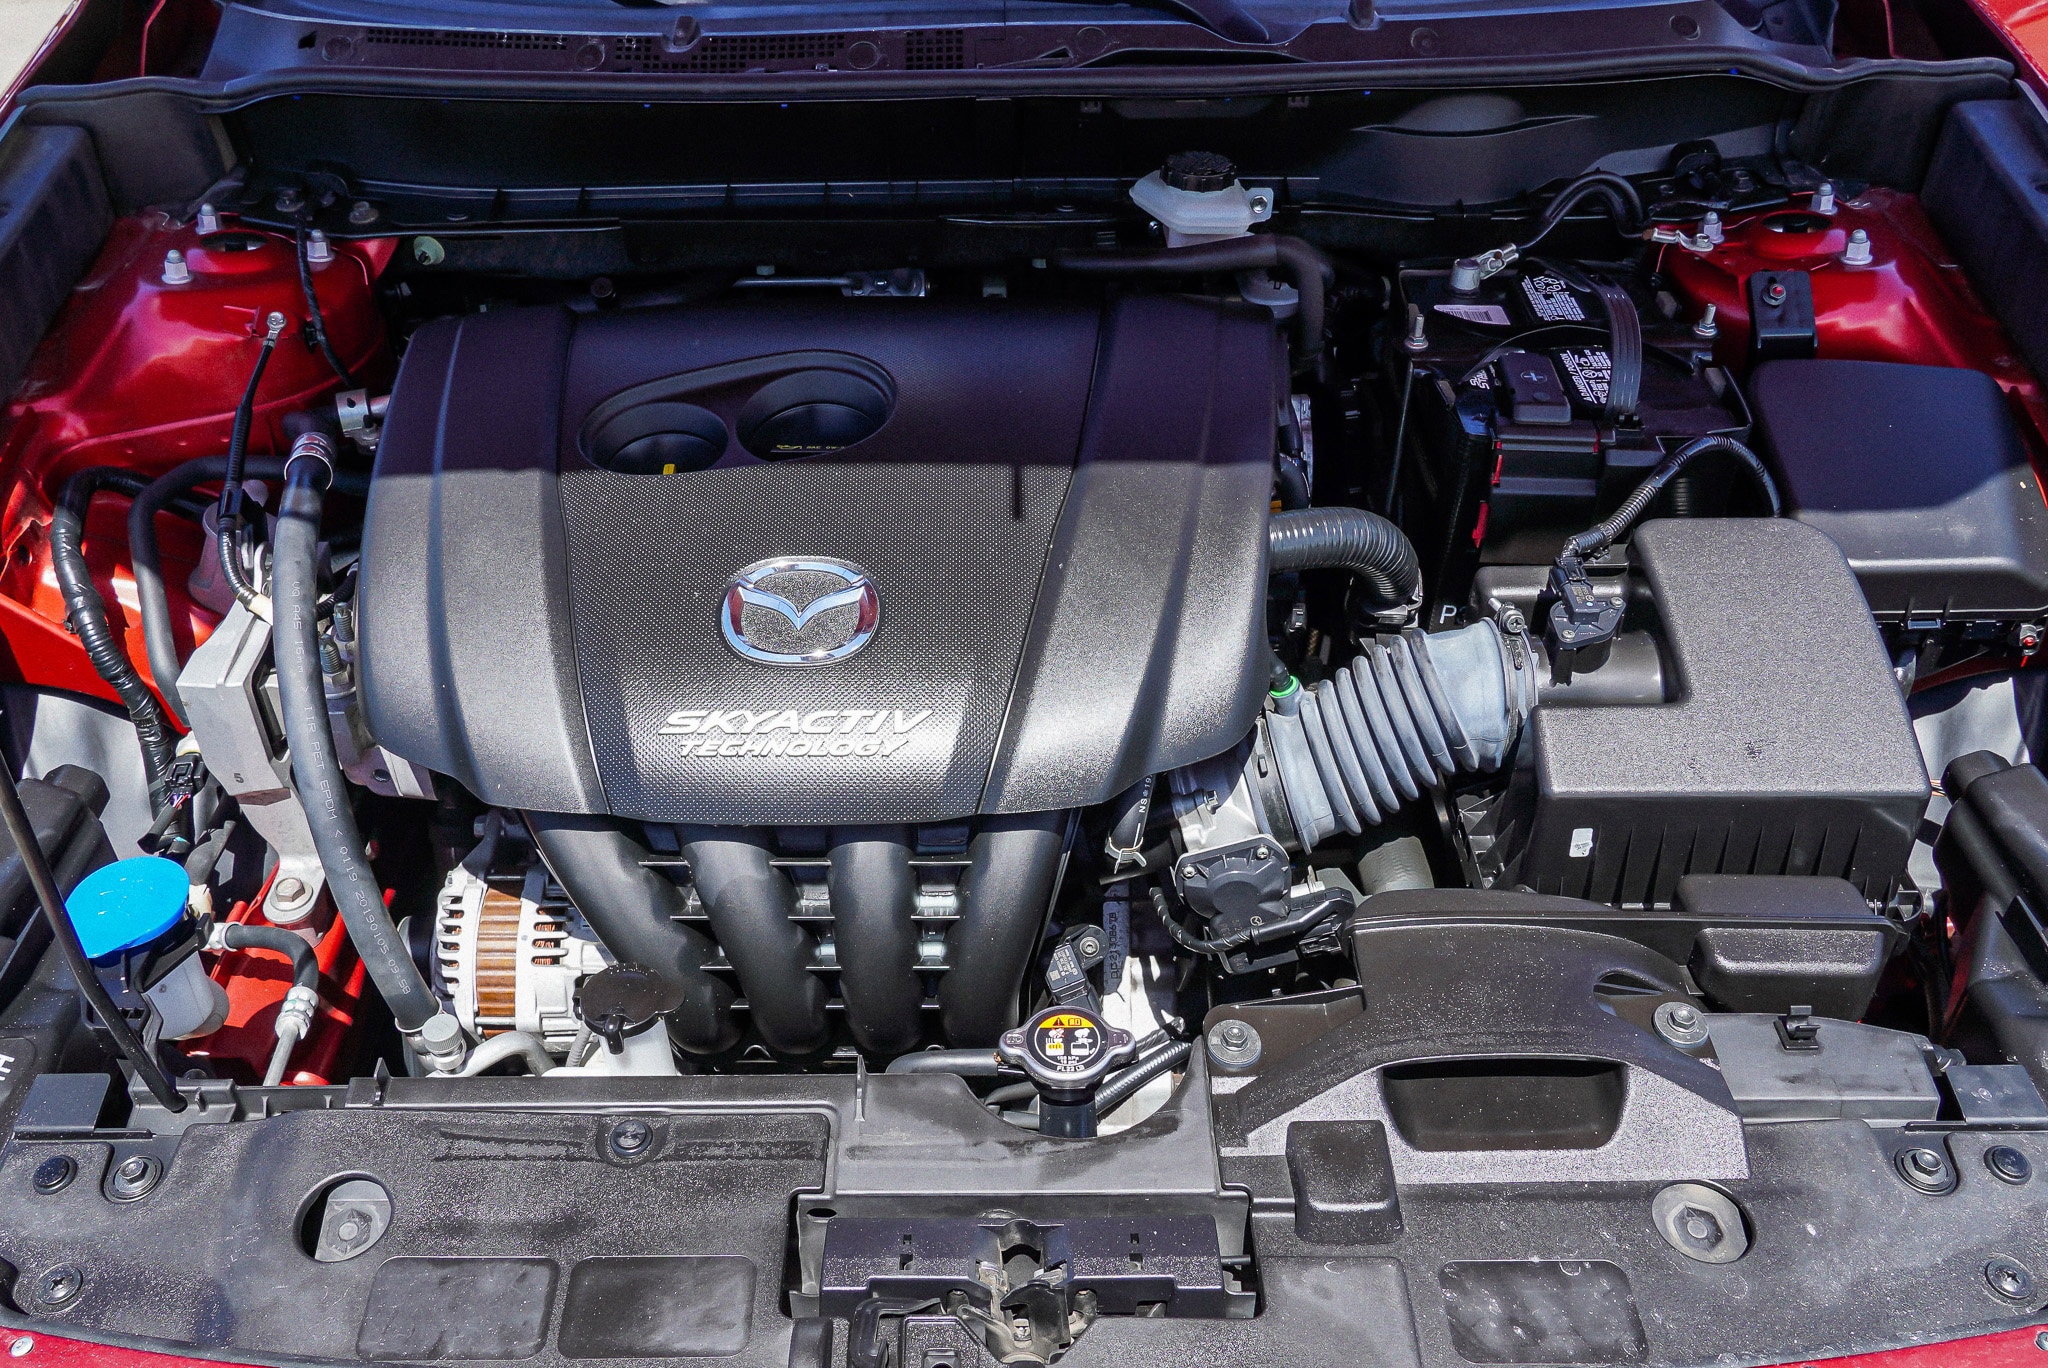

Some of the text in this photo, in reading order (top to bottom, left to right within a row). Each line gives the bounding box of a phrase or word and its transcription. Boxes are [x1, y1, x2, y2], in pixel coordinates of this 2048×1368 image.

[657, 709, 935, 735] SKYACTIV
[680, 740, 910, 758] TECHNOLOGY
[233, 772, 244, 783] 5
[1138, 798, 1148, 813] NS
[311, 741, 325, 770] PET
[320, 779, 338, 820] EPDM
[339, 846, 358, 882] 0119
[355, 891, 390, 955] 20190105
[388, 958, 411, 995] 09:58
